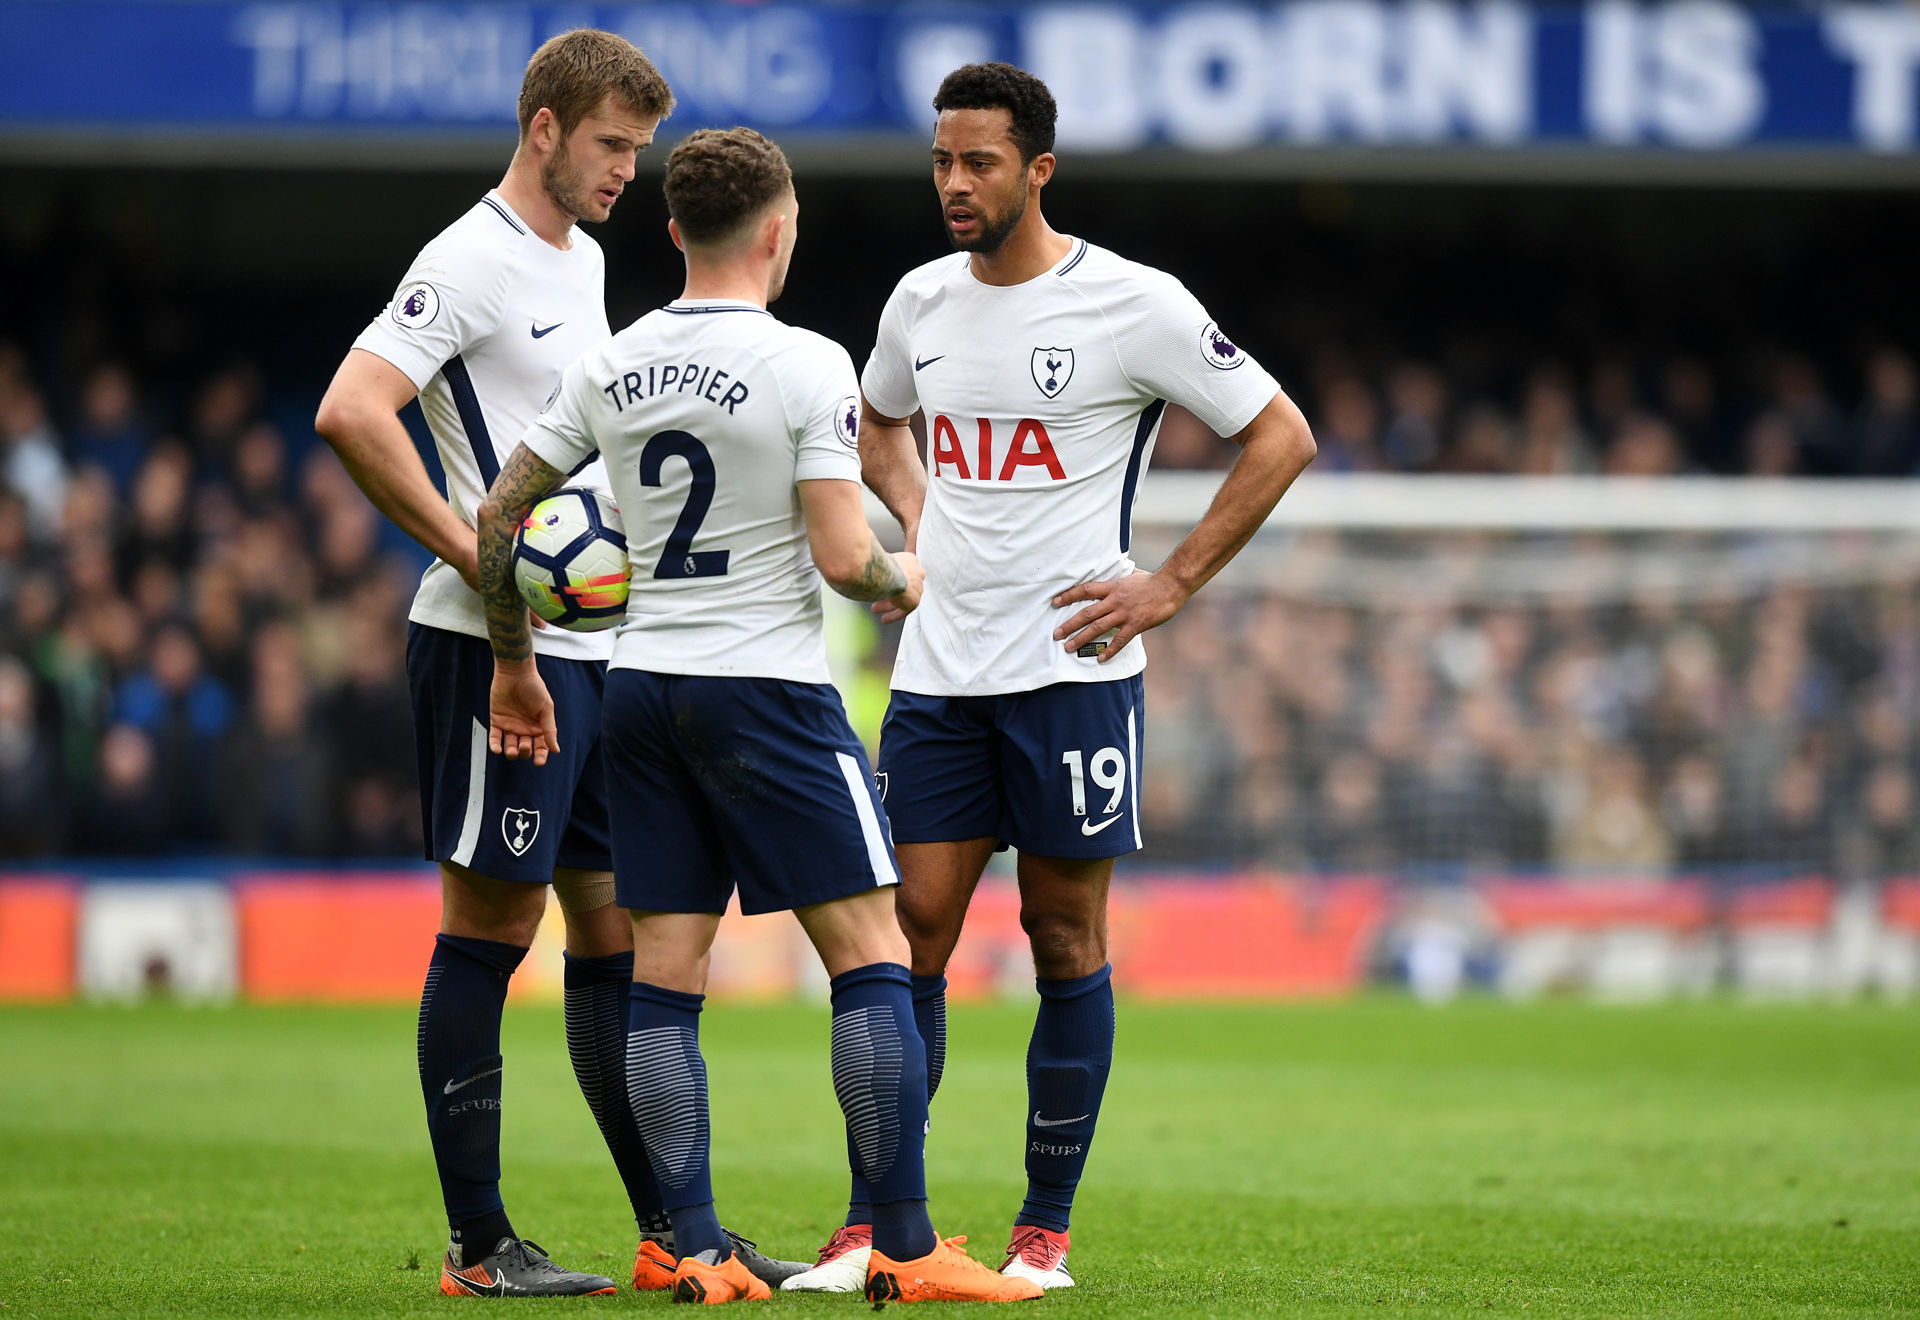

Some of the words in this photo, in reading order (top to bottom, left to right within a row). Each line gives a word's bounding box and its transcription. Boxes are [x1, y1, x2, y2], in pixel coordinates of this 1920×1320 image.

[1024, 2, 1532, 147] BORN
[1584, 2, 1764, 149] IS
[604, 363, 749, 416] TRIPPIER
[934, 414, 1067, 481] AIA
[639, 429, 730, 579] 2
[1062, 747, 1126, 816] 19
[1029, 1141, 1082, 1156] SPURS
